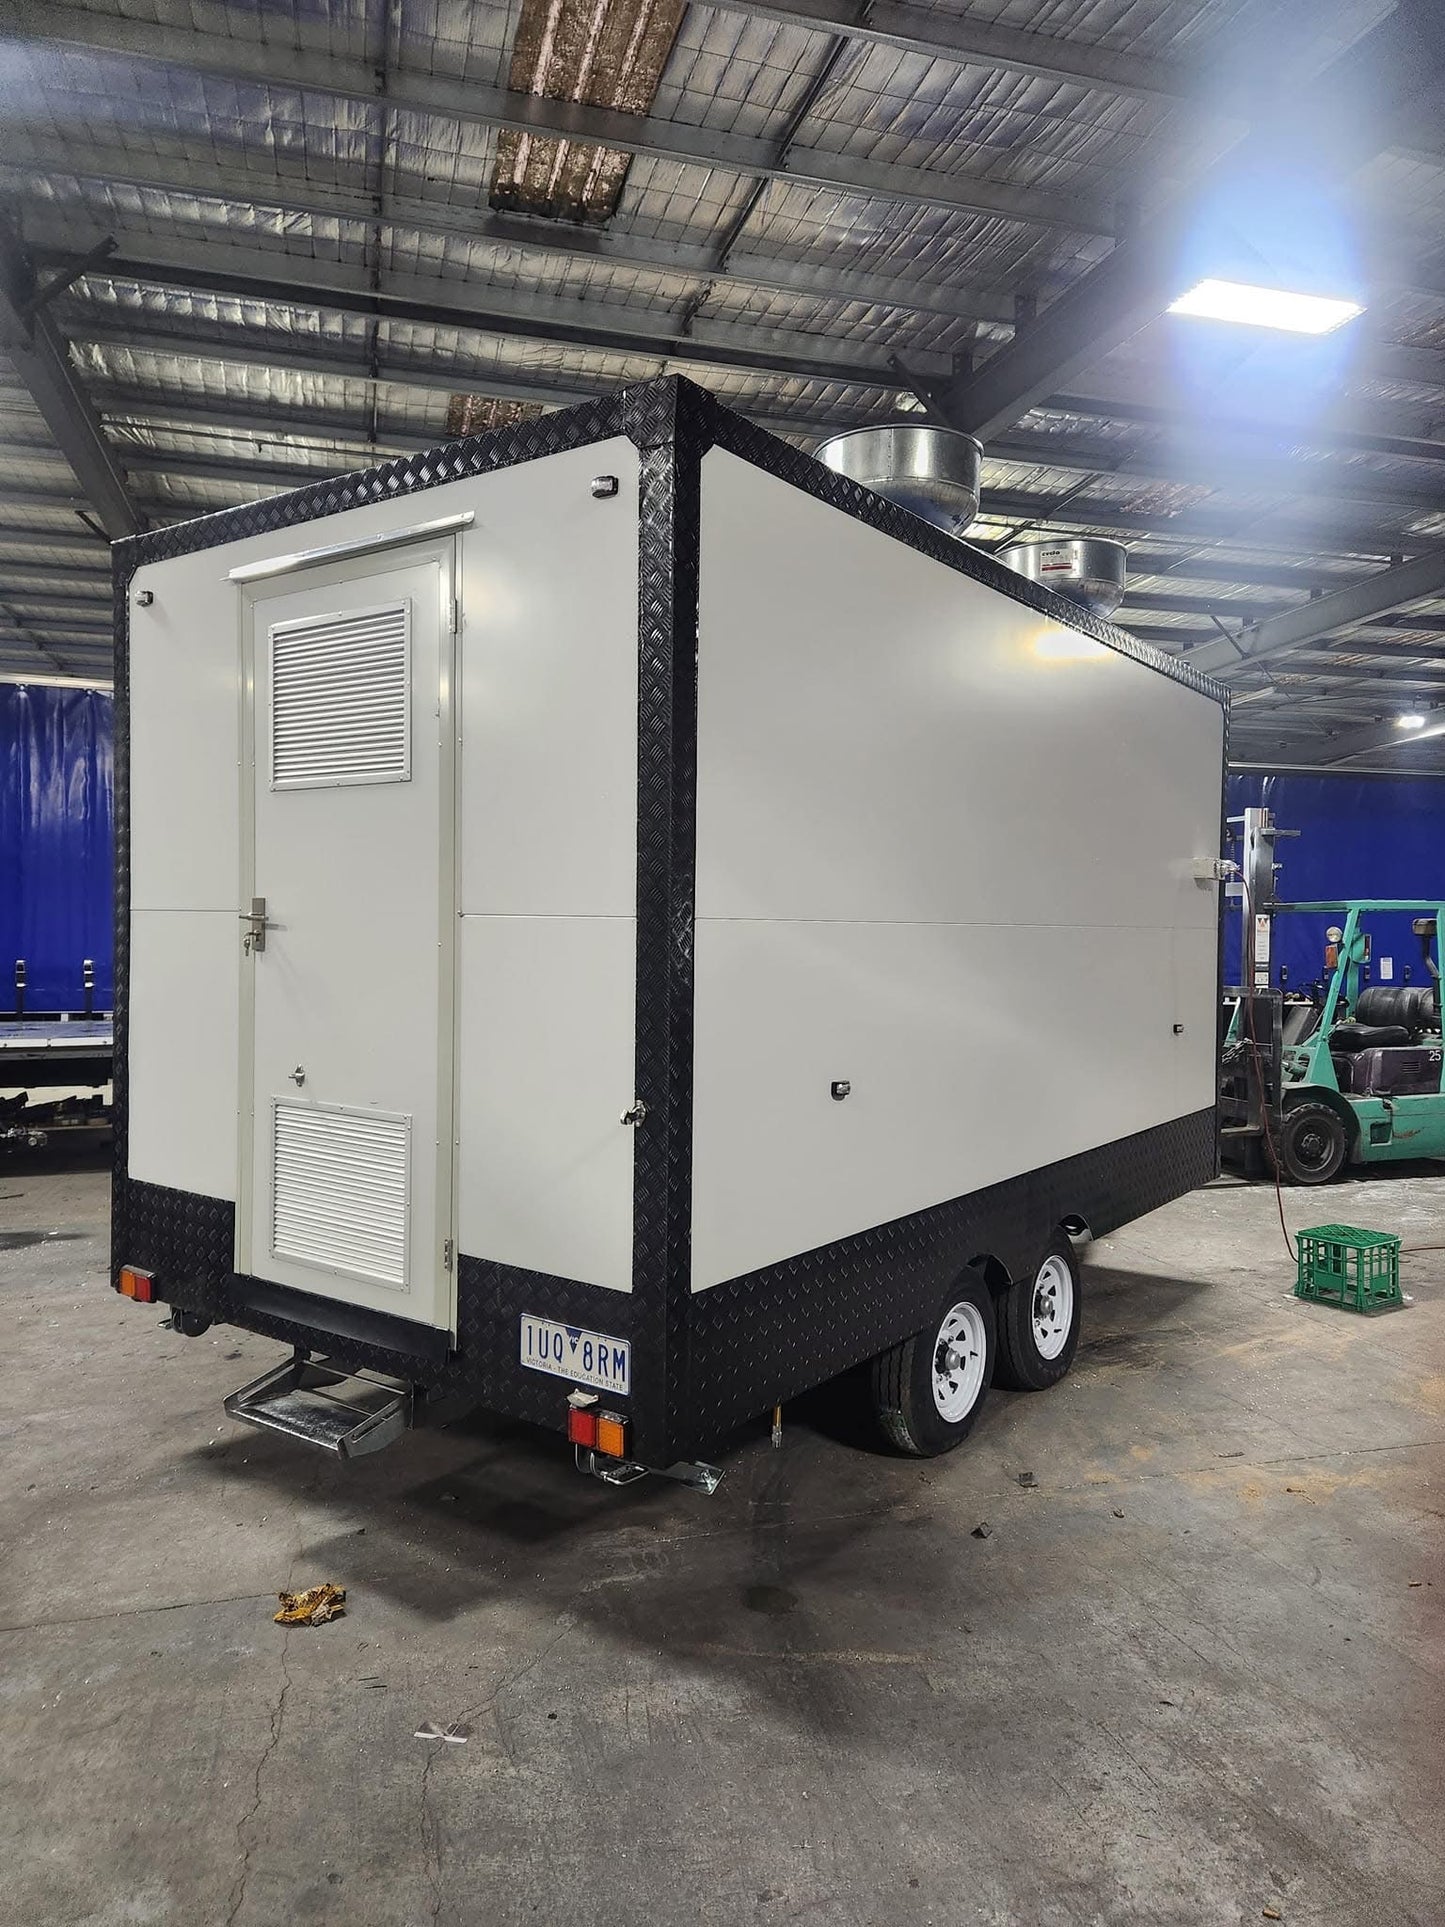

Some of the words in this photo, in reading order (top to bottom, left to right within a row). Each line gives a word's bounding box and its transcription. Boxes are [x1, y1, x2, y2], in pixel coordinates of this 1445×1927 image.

[1429, 1050, 1441, 1061] 25
[527, 1325, 563, 1363] 1UQ
[583, 1341, 626, 1382] 8RM
[526, 1357, 553, 1371] VICTORIA
[558, 1366, 569, 1375] THE
[570, 1370, 604, 1385] EDUCATION
[605, 1381, 624, 1391] STATE
